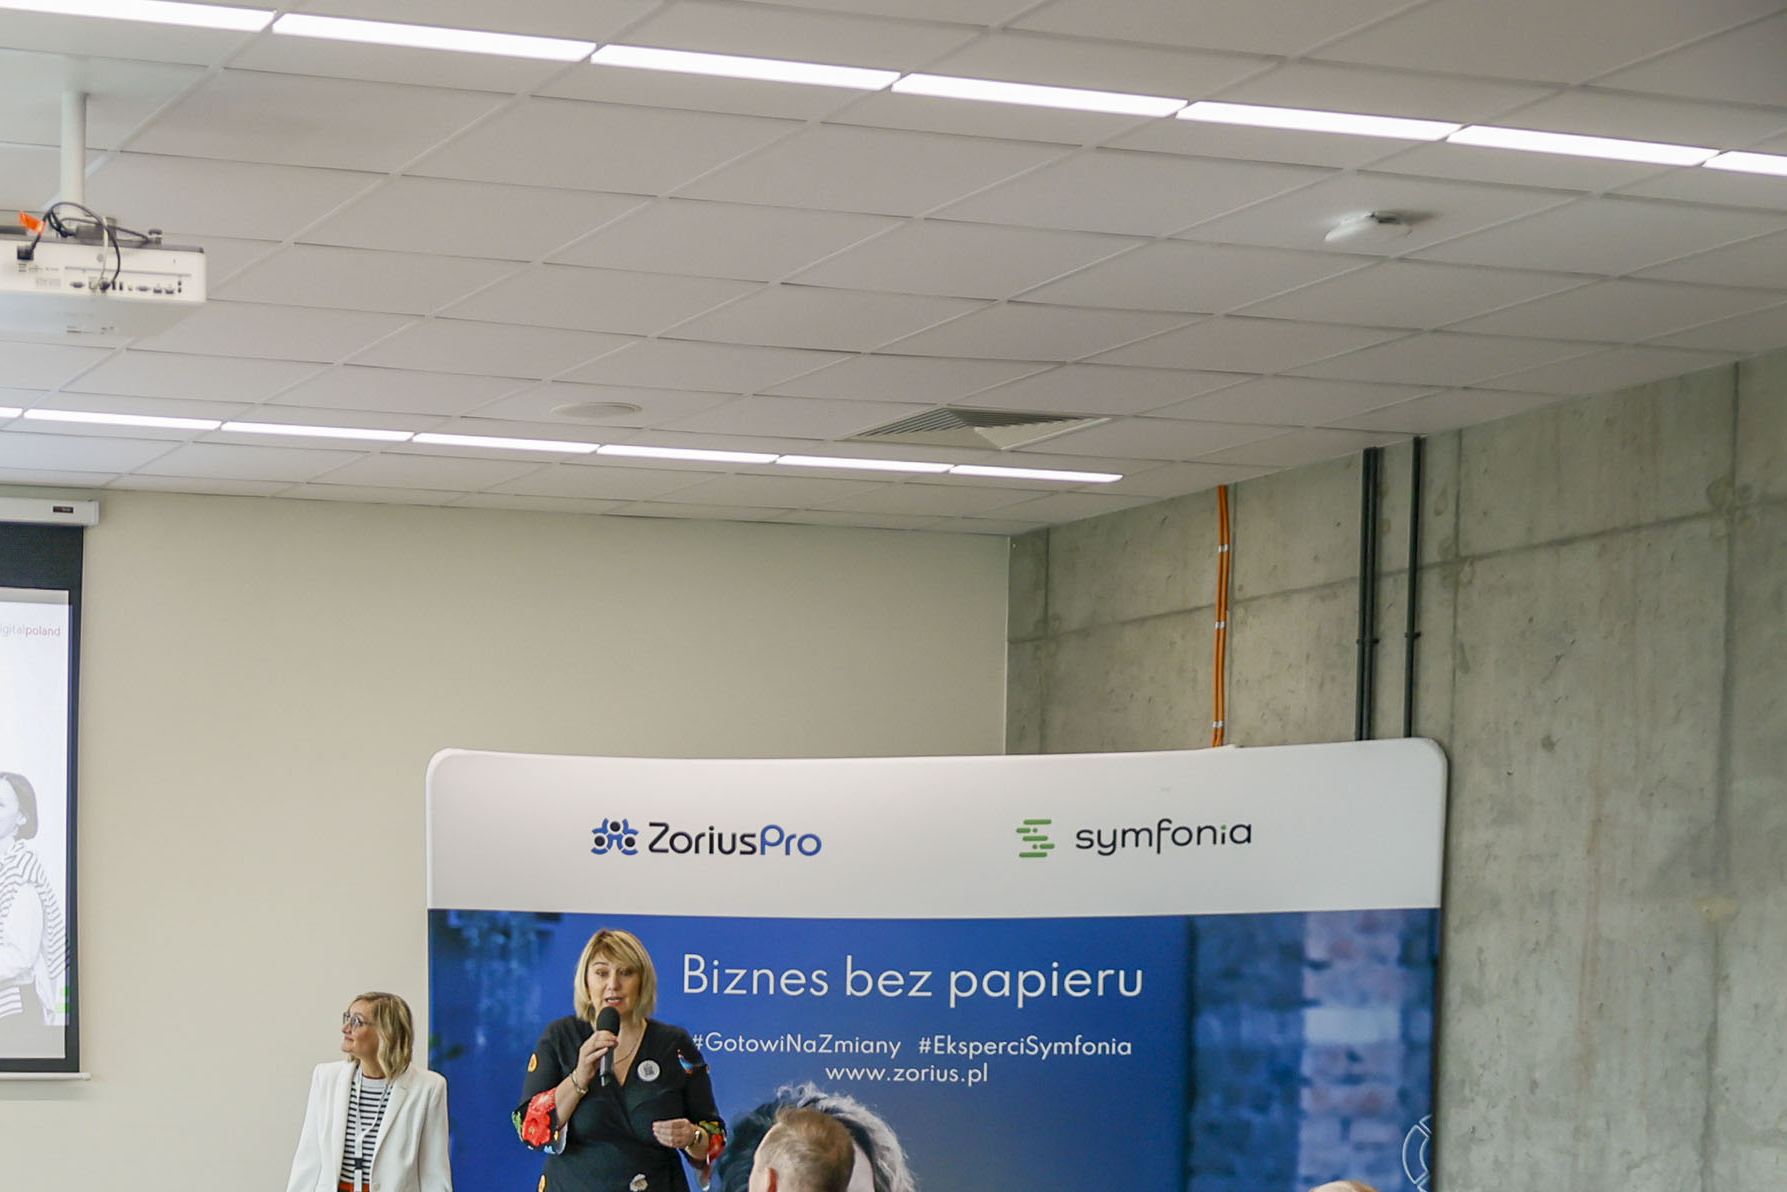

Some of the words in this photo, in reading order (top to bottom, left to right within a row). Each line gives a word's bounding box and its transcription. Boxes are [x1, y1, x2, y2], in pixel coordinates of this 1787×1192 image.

[648, 820, 823, 860] ZoriusPro
[1075, 817, 1253, 858] symfonia
[682, 953, 829, 998] Biznes
[844, 954, 933, 998] bez
[948, 957, 1143, 1010] papieru
[692, 1032, 902, 1060] #GotowiNaZmiany
[918, 1032, 1133, 1061] #EksperciSymfonia
[825, 1062, 989, 1087] www.zorius.pl
